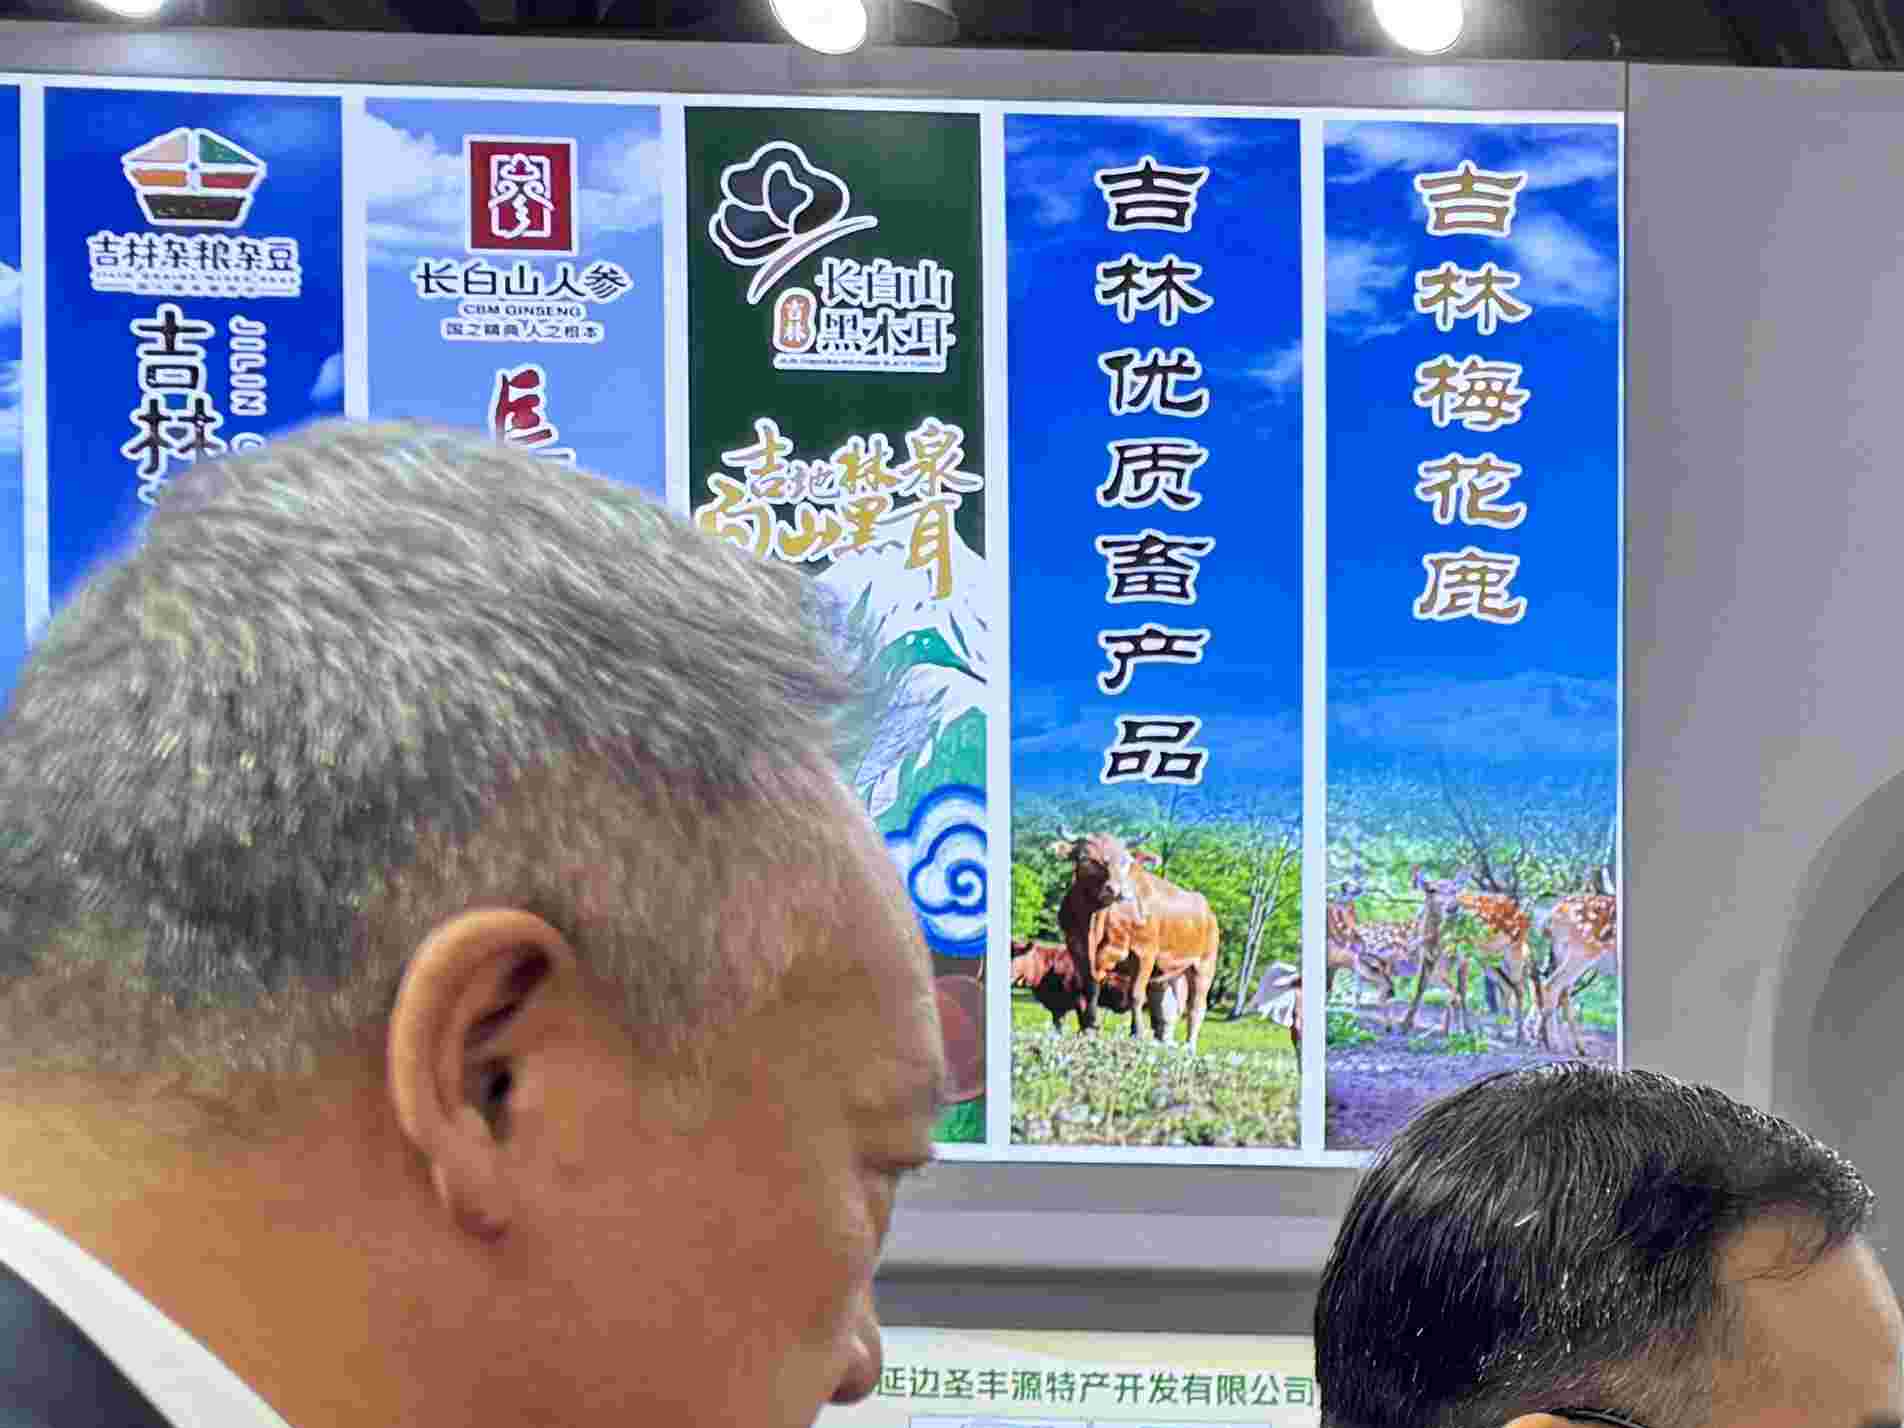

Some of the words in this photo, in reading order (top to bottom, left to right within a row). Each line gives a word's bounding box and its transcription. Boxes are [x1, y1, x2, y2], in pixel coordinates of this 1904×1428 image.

[416, 261, 628, 299] 长白山人参
[818, 258, 953, 308] 长白山
[818, 311, 955, 354] 黑木耳
[124, 306, 226, 482] 吉林
[1416, 163, 1529, 622] 吉林梅花鹿
[1099, 158, 1211, 781] 吉林优质畜产品
[877, 1367, 1314, 1406] 延边圣丰源特产开发有限公司
